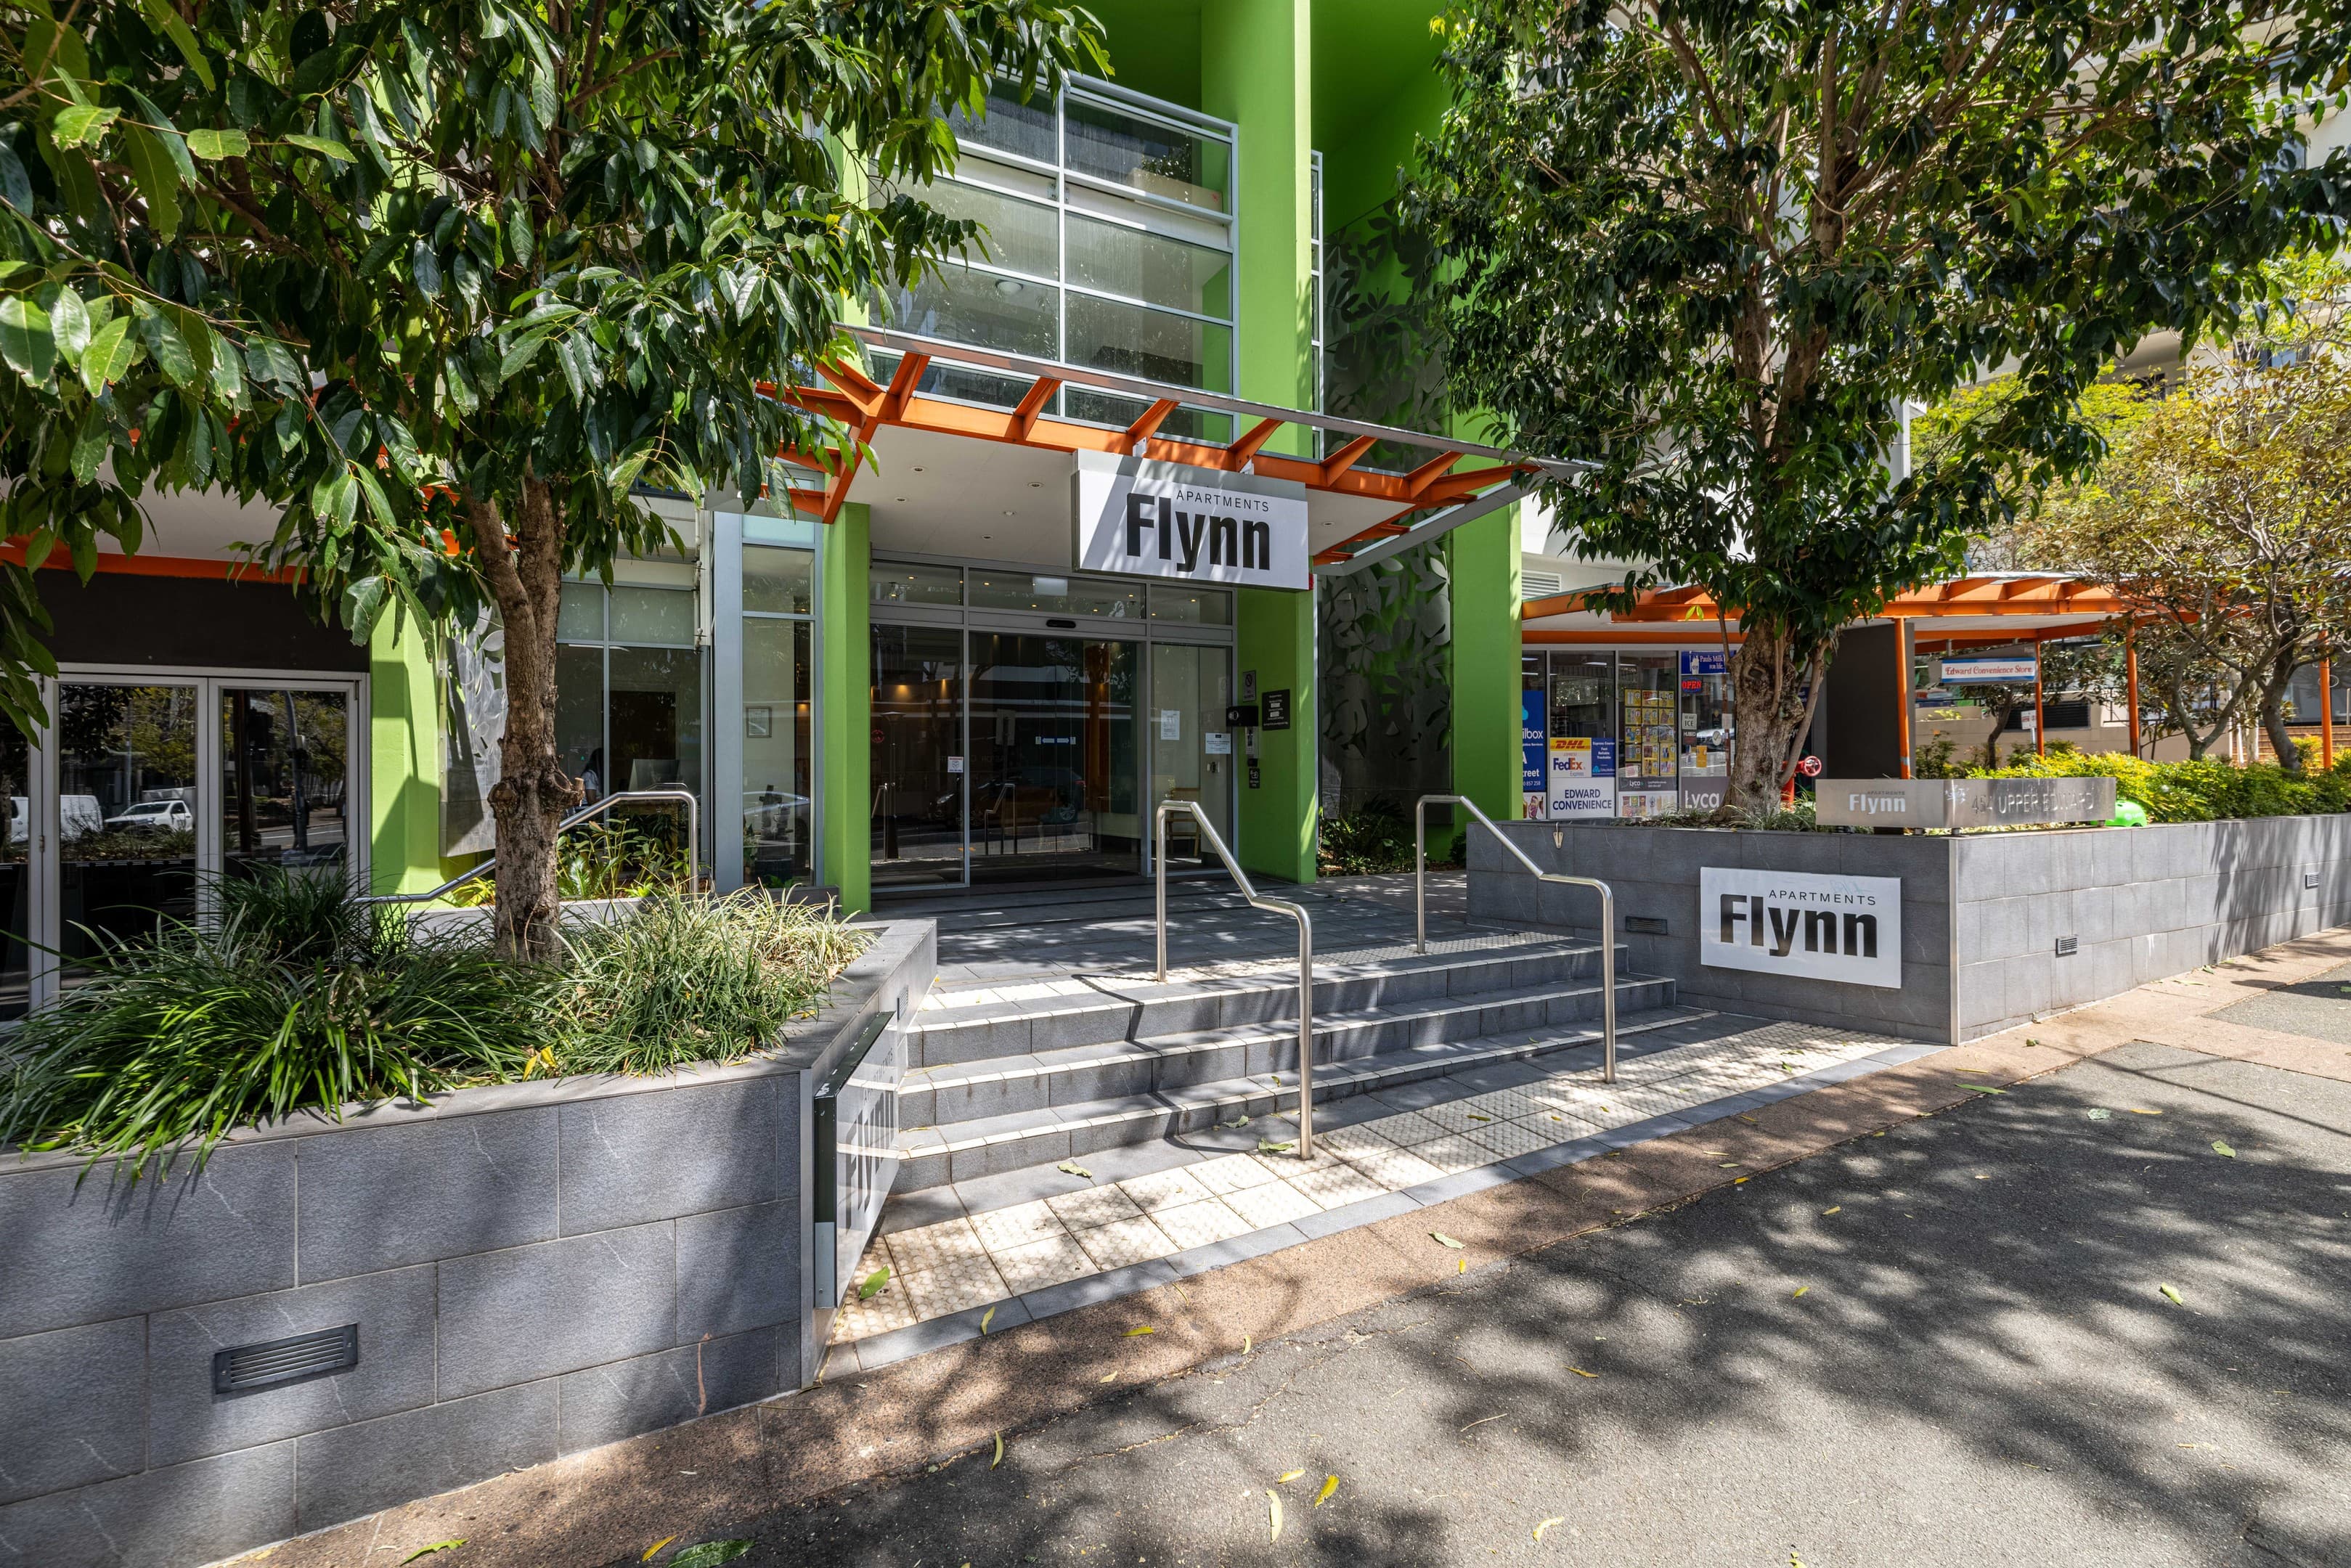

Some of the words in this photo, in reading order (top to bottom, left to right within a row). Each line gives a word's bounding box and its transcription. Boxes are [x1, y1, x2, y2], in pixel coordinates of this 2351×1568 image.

[1176, 489, 1269, 512] APARTMENTS
[1126, 492, 1270, 572] Flynn
[1945, 666, 1972, 675] Edward
[1973, 666, 2013, 674] Convenience
[2015, 664, 2032, 674] Store
[1682, 680, 1702, 690] OPEN
[1523, 728, 1544, 740] ilbox
[1555, 740, 1585, 749] DHL
[1553, 757, 1583, 771] FedEx
[1523, 769, 1540, 777] reet
[1565, 789, 1600, 799] EDWARD
[1684, 790, 1720, 809] Lyca
[1552, 800, 1612, 810] CONVENIENCE
[1849, 793, 1906, 814] Flynn
[1998, 793, 2039, 814] UPPER
[1769, 889, 1876, 906] APARTMENTS
[1720, 894, 1878, 958] Flynn
[863, 1047, 893, 1106] APRTMENTS
[846, 1076, 894, 1236] Flynn
